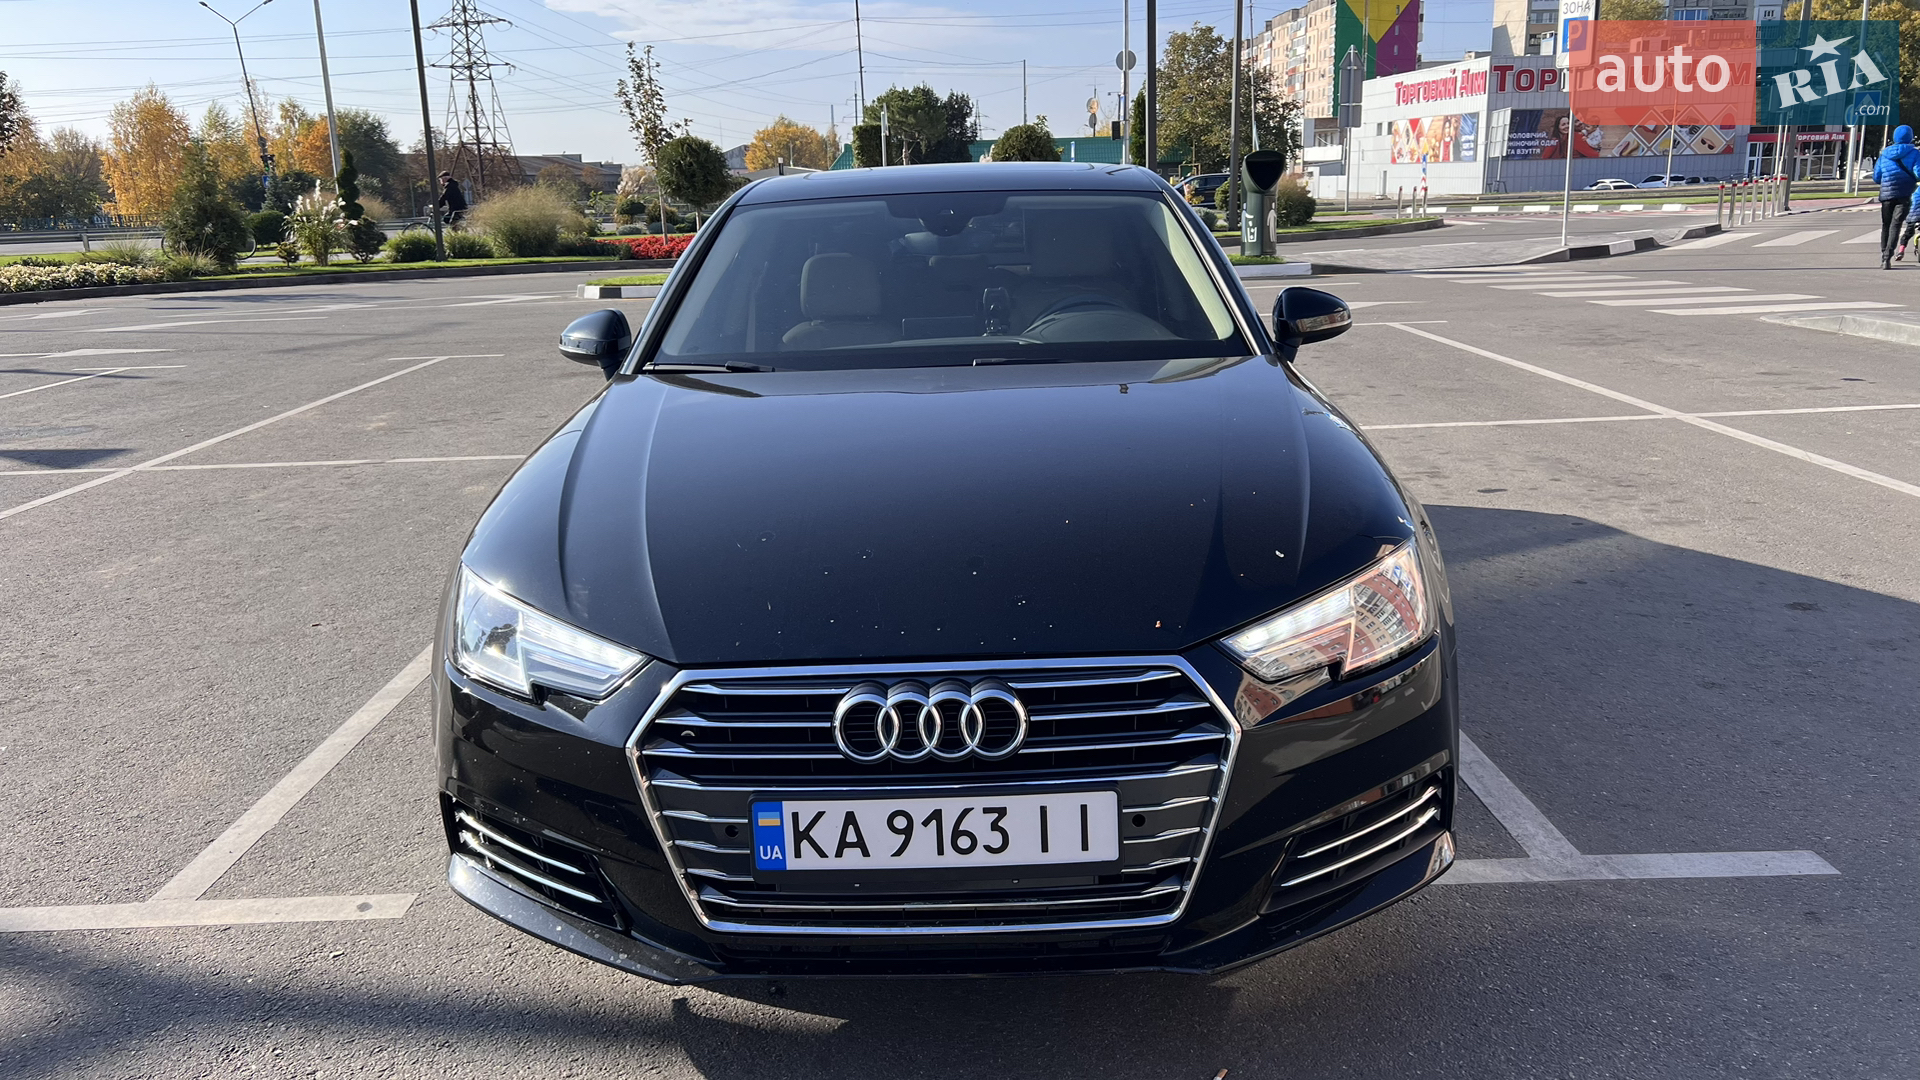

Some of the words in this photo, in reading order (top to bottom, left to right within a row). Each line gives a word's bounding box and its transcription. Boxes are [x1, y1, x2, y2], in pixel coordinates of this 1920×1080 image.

[1563, 1, 1591, 14] ЗОНА
[791, 810, 871, 858] KA
[887, 806, 1009, 858] 9163
[759, 845, 783, 860] UA
